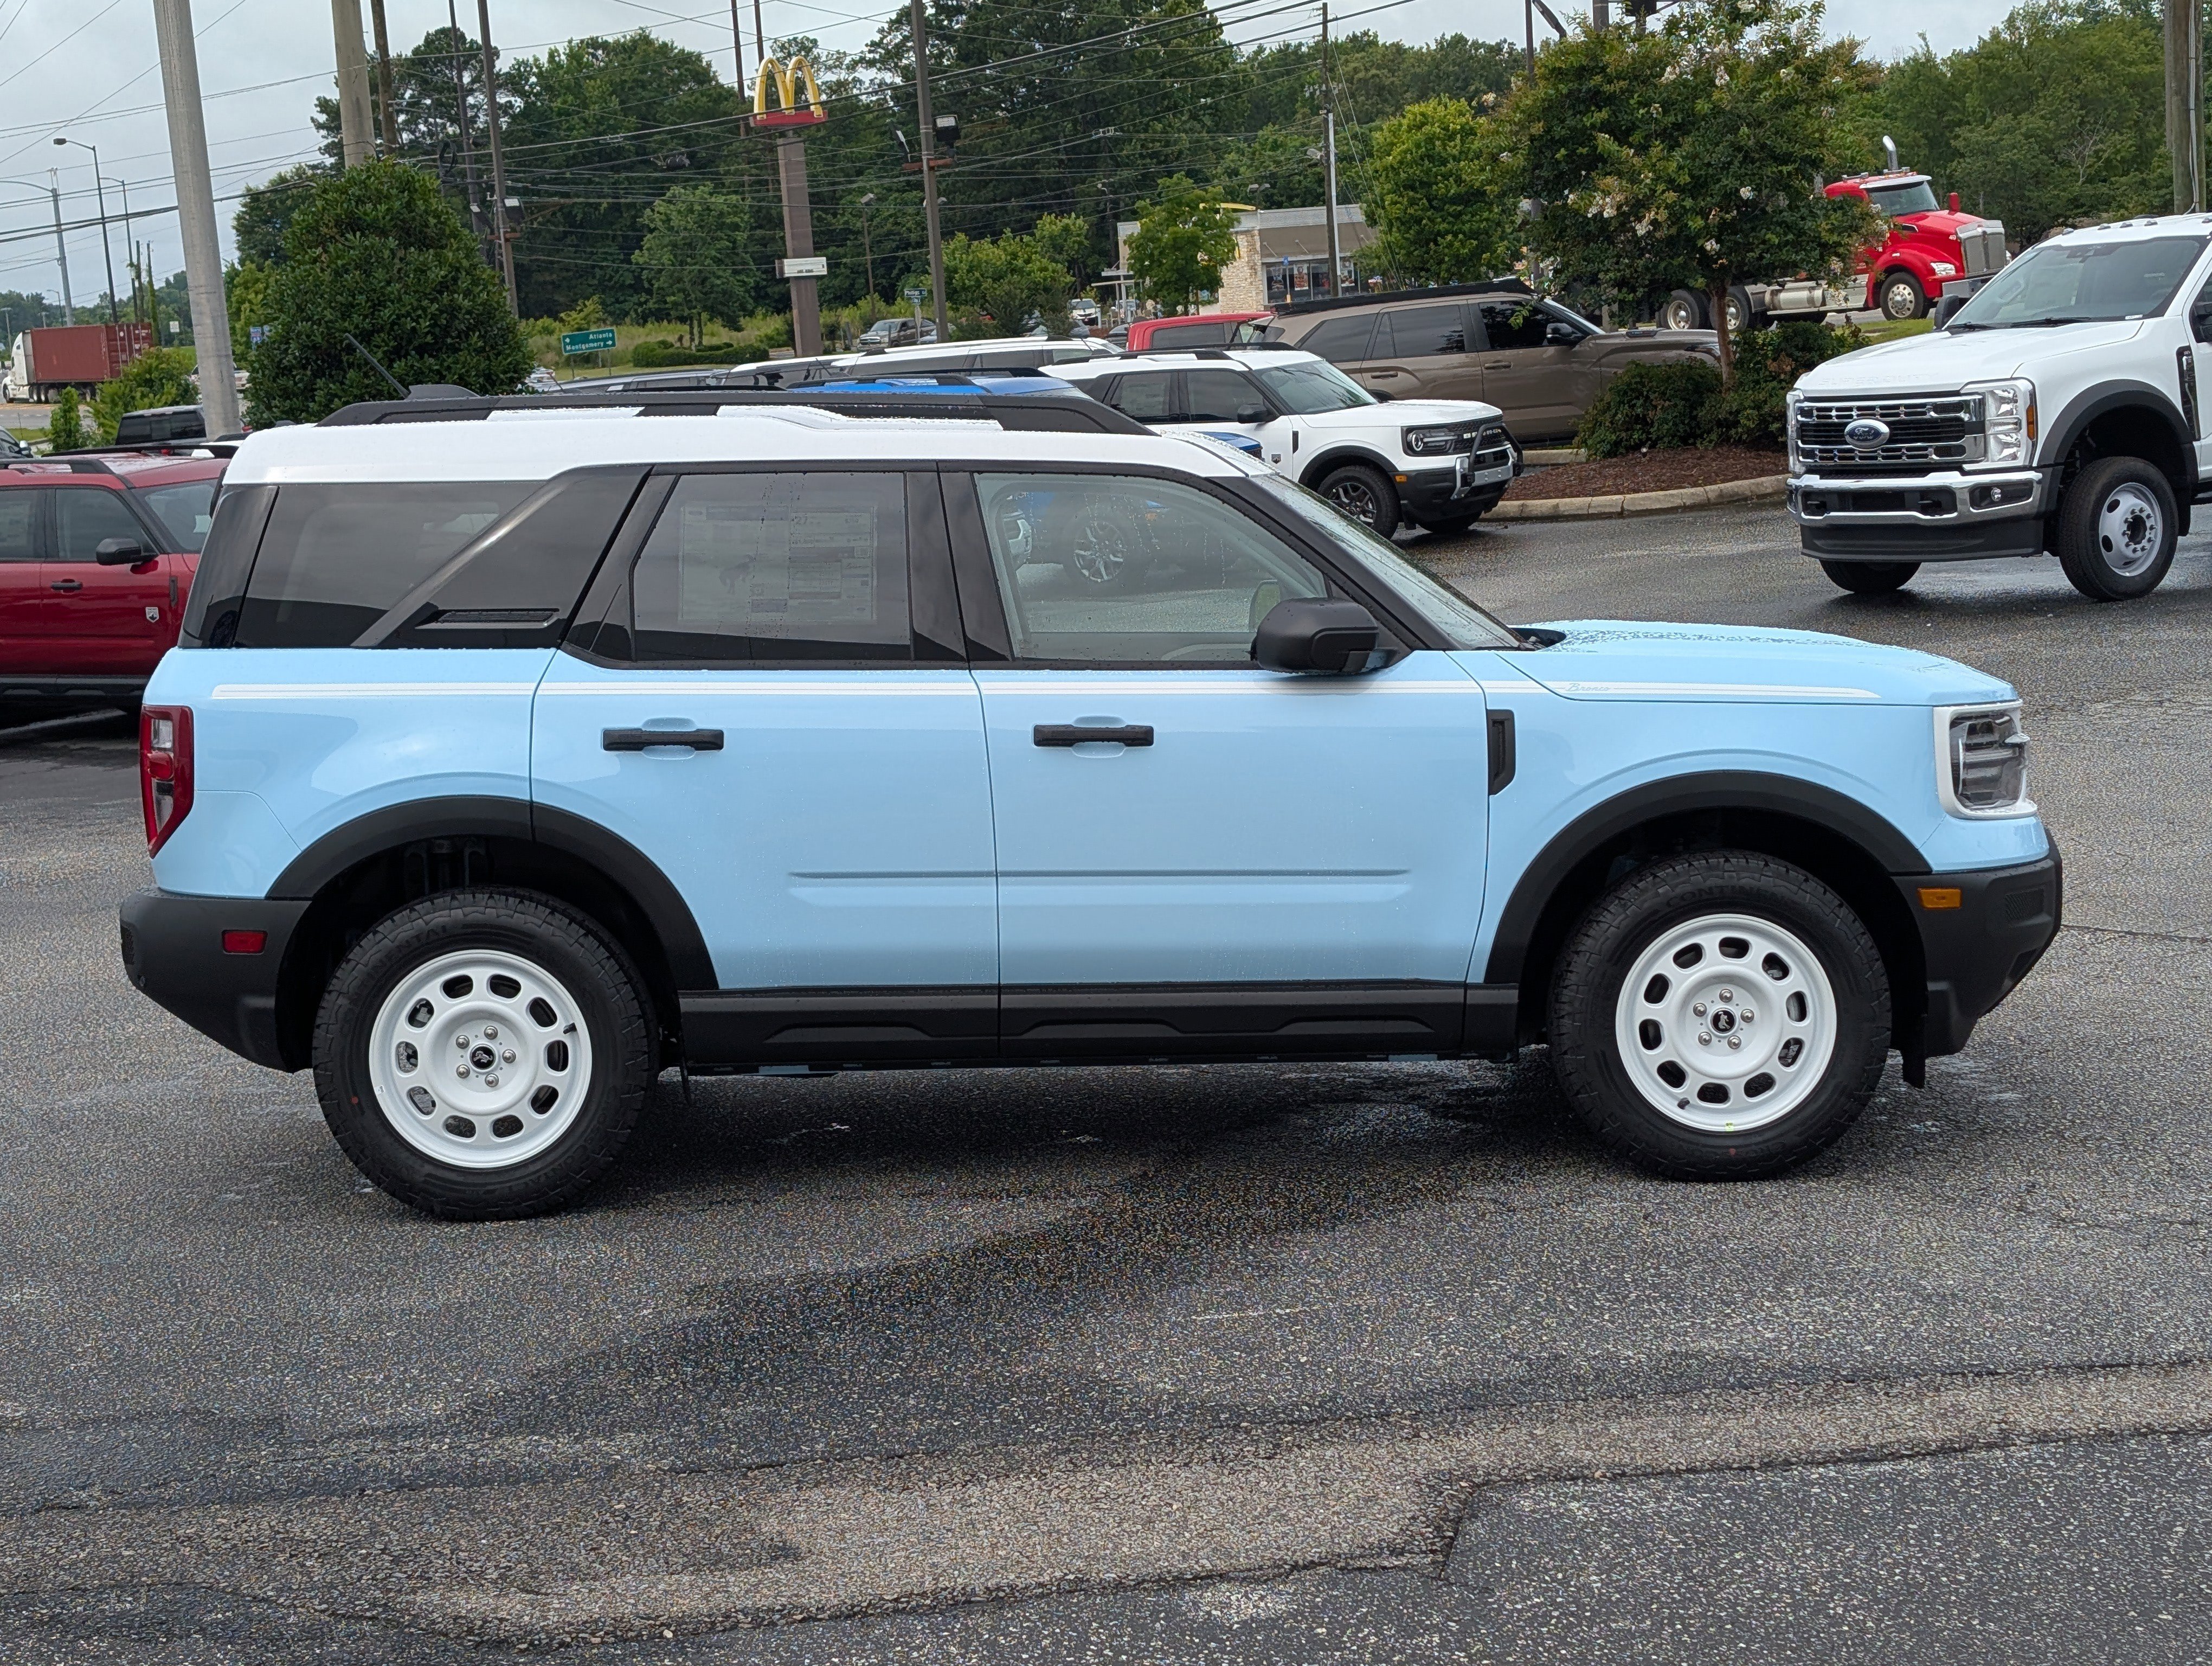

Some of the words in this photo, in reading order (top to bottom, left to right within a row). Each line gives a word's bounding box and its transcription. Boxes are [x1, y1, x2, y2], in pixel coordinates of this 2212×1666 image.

[565, 341, 604, 350] Montgomery
[1853, 427, 1875, 440] Ford
[1565, 682, 1610, 691] Bronco
